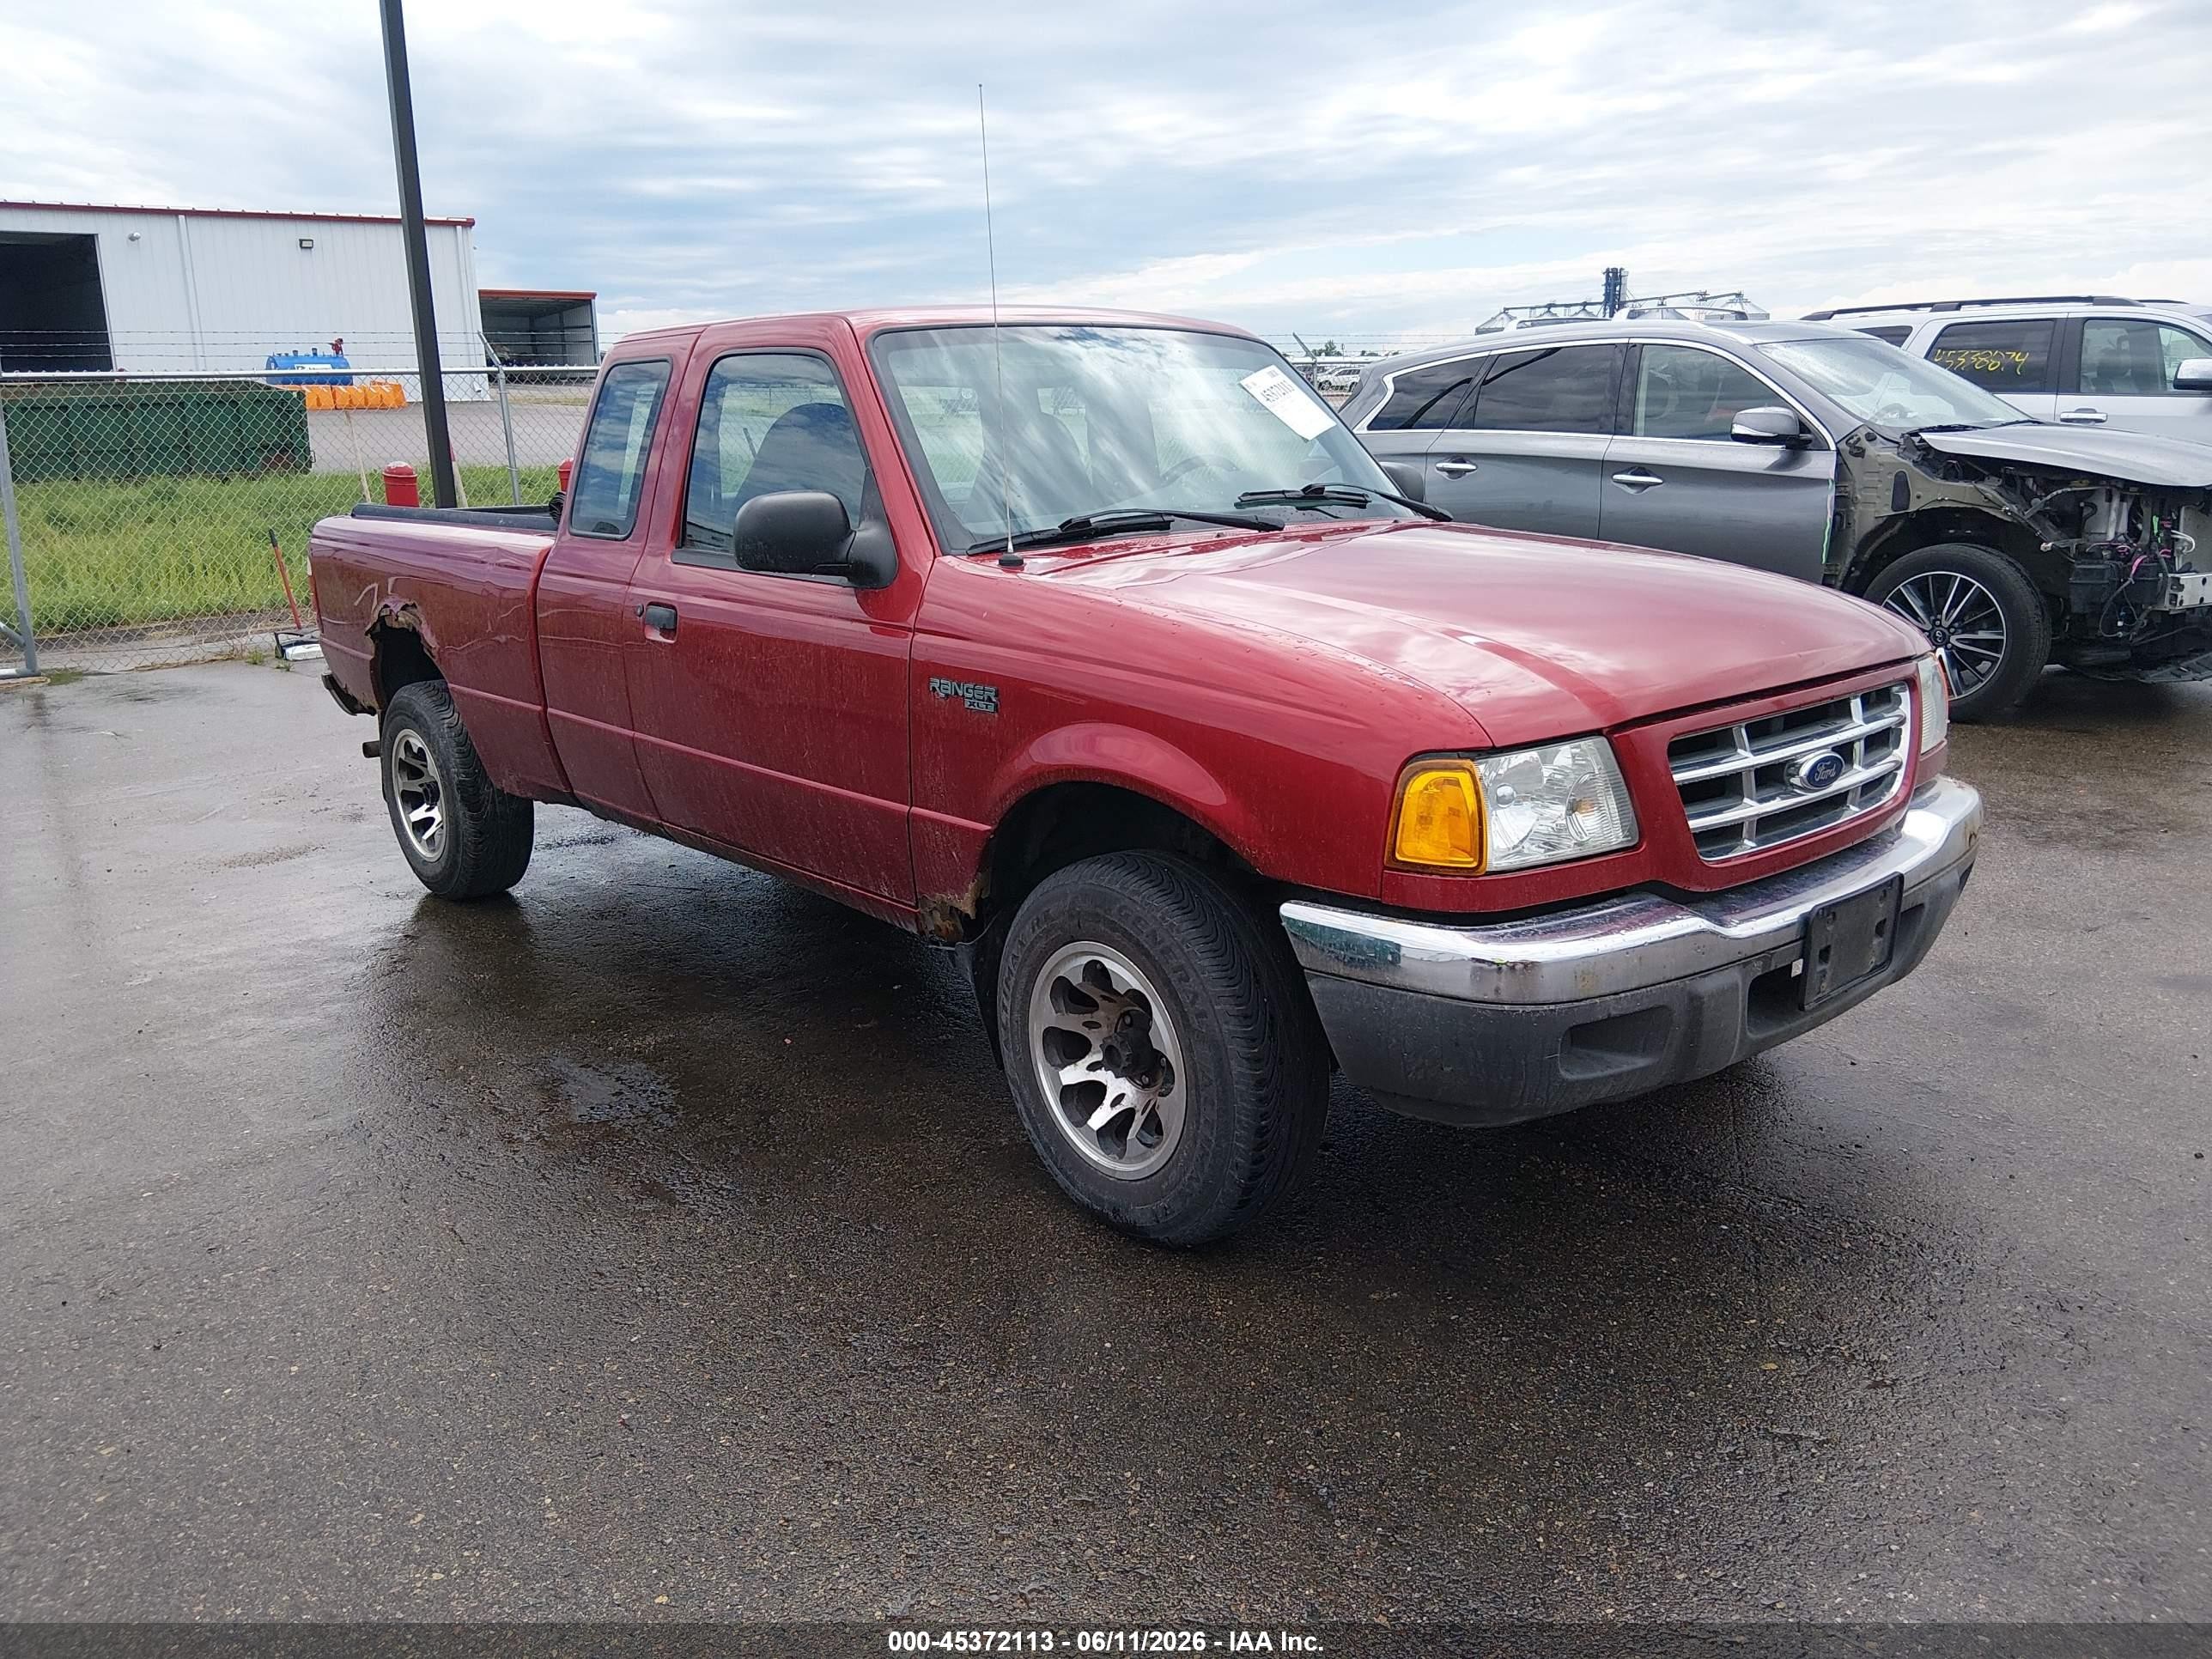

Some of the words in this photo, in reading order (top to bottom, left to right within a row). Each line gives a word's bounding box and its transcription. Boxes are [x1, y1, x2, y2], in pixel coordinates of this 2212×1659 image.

[929, 678, 997, 702] RANGER
[967, 700, 992, 710] XLT
[1814, 762, 1836, 781] Ford
